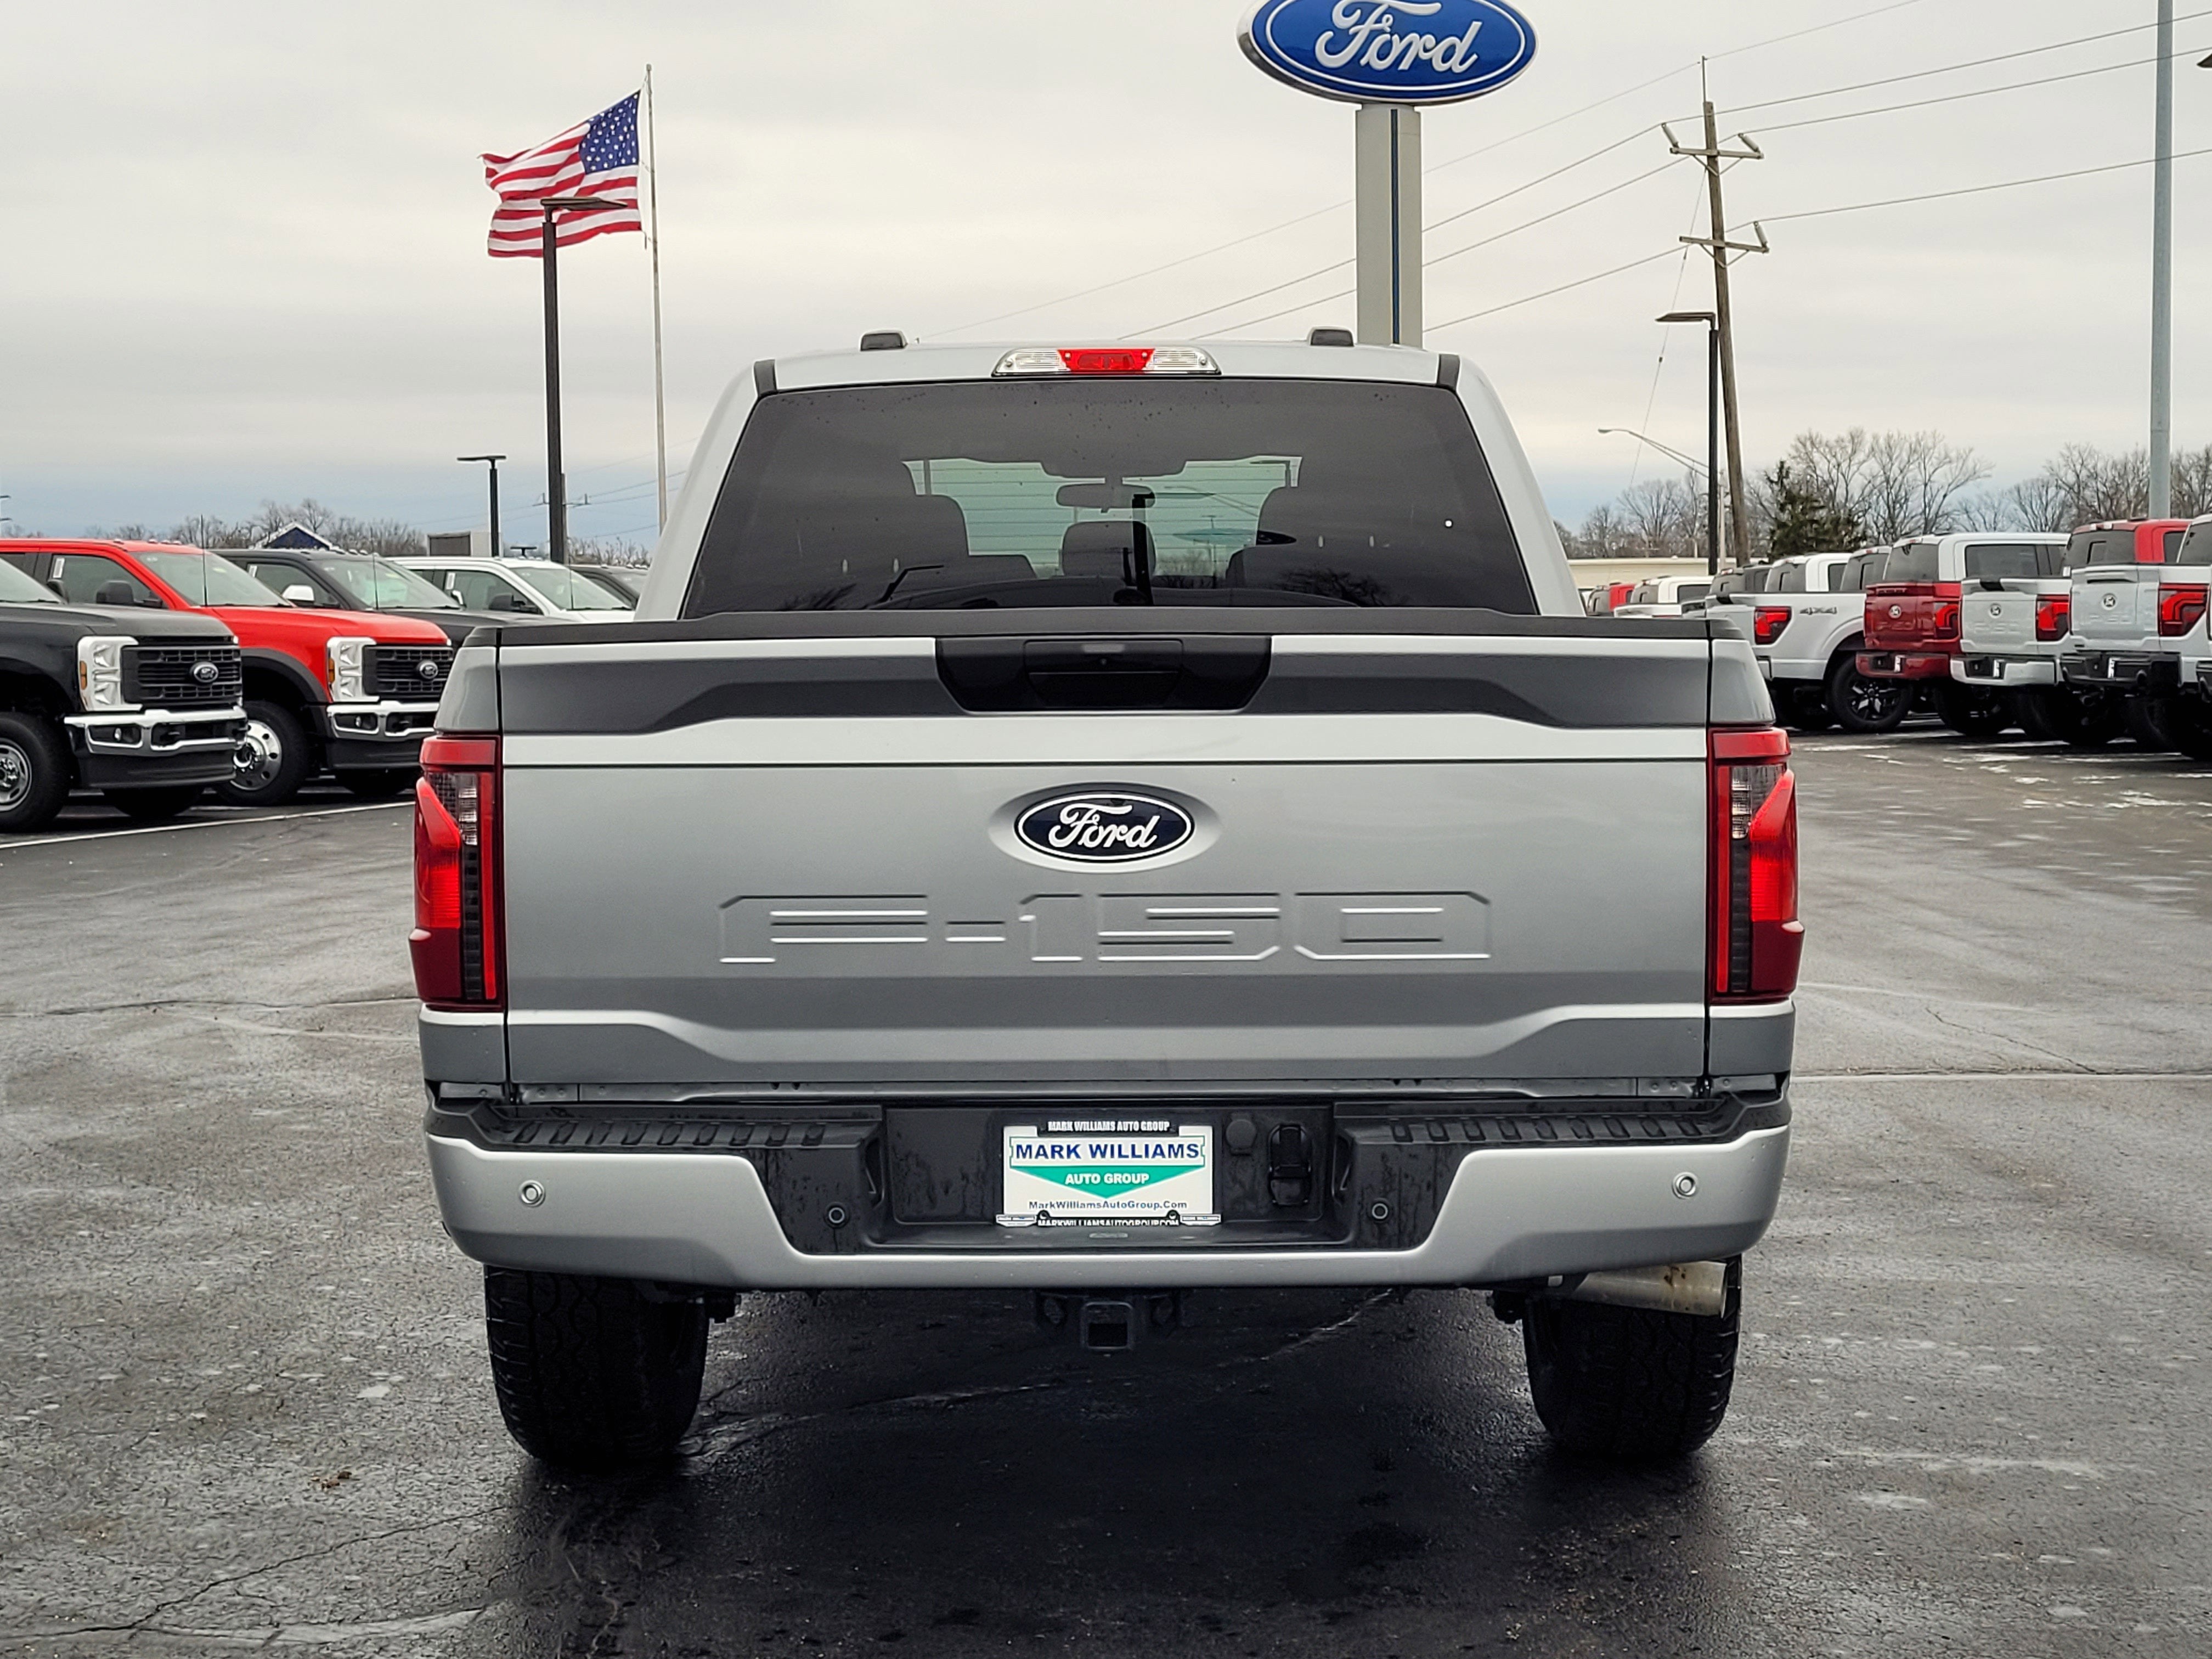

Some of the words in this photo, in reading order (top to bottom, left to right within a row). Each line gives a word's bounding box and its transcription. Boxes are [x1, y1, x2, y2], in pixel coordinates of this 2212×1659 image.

[1314, 0, 1482, 74] Ford
[1048, 803, 1160, 848] Ford
[719, 891, 1491, 963] F-150
[1048, 1121, 1073, 1131] MARK
[1074, 1121, 1116, 1131] WILLIAMS
[1117, 1121, 1139, 1131] AUTO
[1140, 1121, 1170, 1131] GROUP
[1015, 1144, 1081, 1159] MARK
[1089, 1143, 1199, 1159] WILLIAMS
[1065, 1173, 1101, 1184] AUTO
[1104, 1173, 1149, 1184] GROUP
[1029, 1200, 1187, 1210] MarkWilliamsAutoGroup.Com
